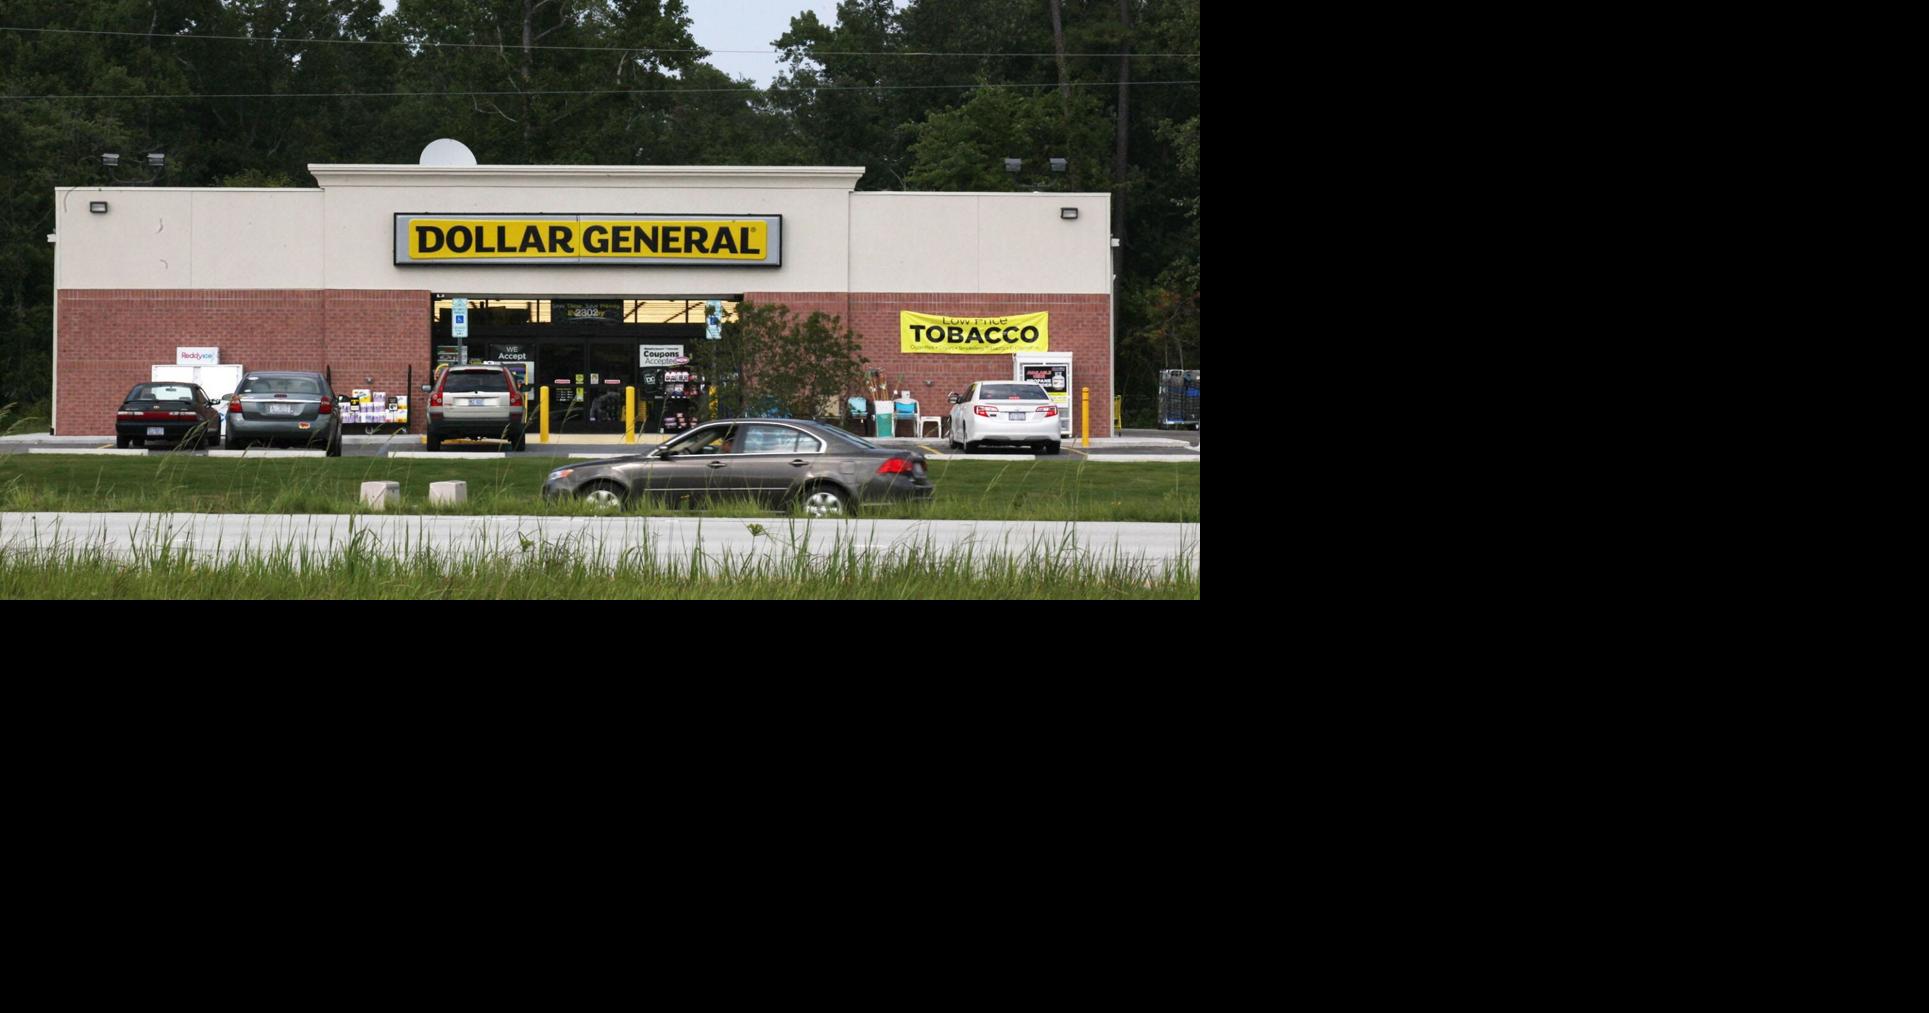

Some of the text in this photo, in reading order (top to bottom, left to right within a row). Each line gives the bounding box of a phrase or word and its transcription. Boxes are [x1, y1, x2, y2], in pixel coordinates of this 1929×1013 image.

[415, 225, 761, 255] DOLLAR GENERAL
[575, 308, 599, 317] 2302
[909, 324, 1039, 344] TOBACCO
[498, 352, 527, 361] Accept
[643, 350, 680, 359] Coupons
